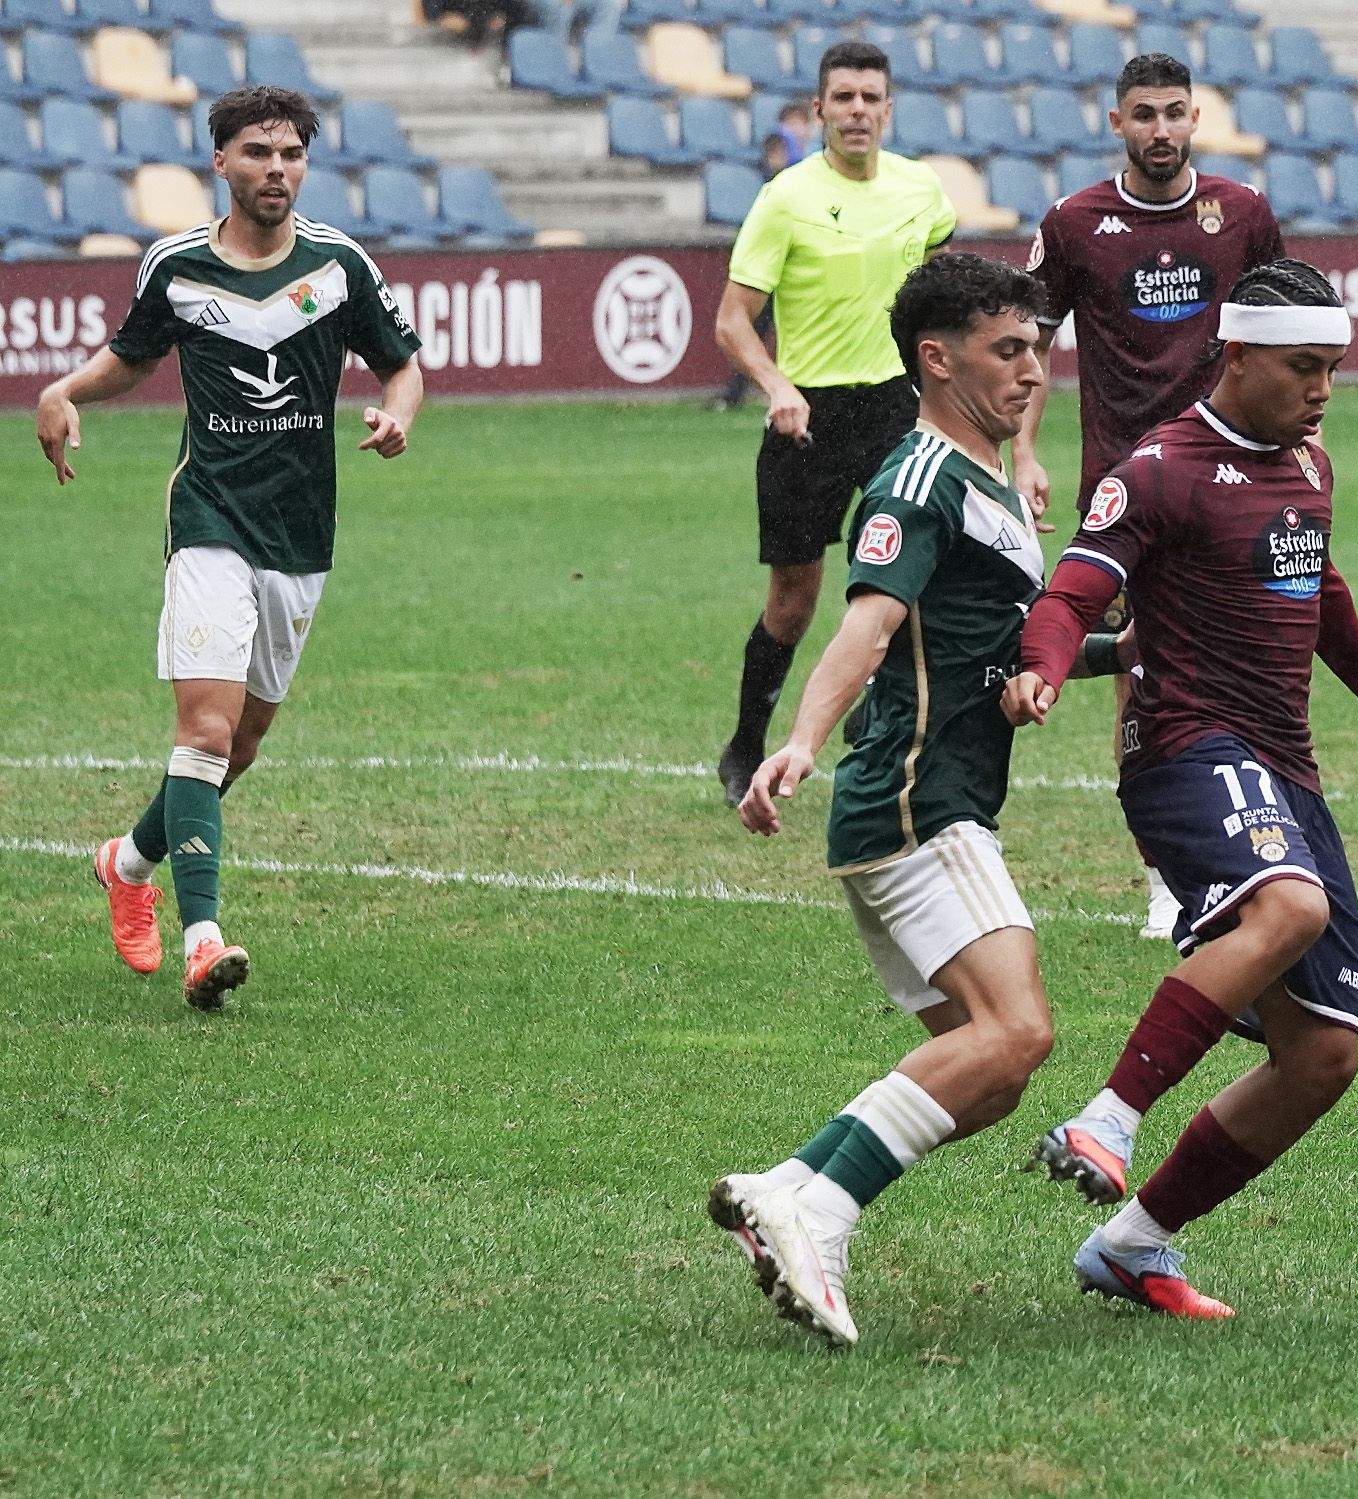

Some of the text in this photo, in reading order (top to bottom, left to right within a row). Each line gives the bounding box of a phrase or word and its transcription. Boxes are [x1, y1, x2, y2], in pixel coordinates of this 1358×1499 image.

[1134, 266, 1201, 288] Estrella
[1137, 284, 1199, 305] Galicia
[0, 295, 107, 348] SUS
[208, 412, 323, 433] Extremadura
[1269, 530, 1324, 555] Estrella
[1273, 552, 1322, 577] Galicia
[1213, 760, 1278, 811] 17
[1241, 807, 1279, 820] XUNTA
[1243, 816, 1259, 828] DE
